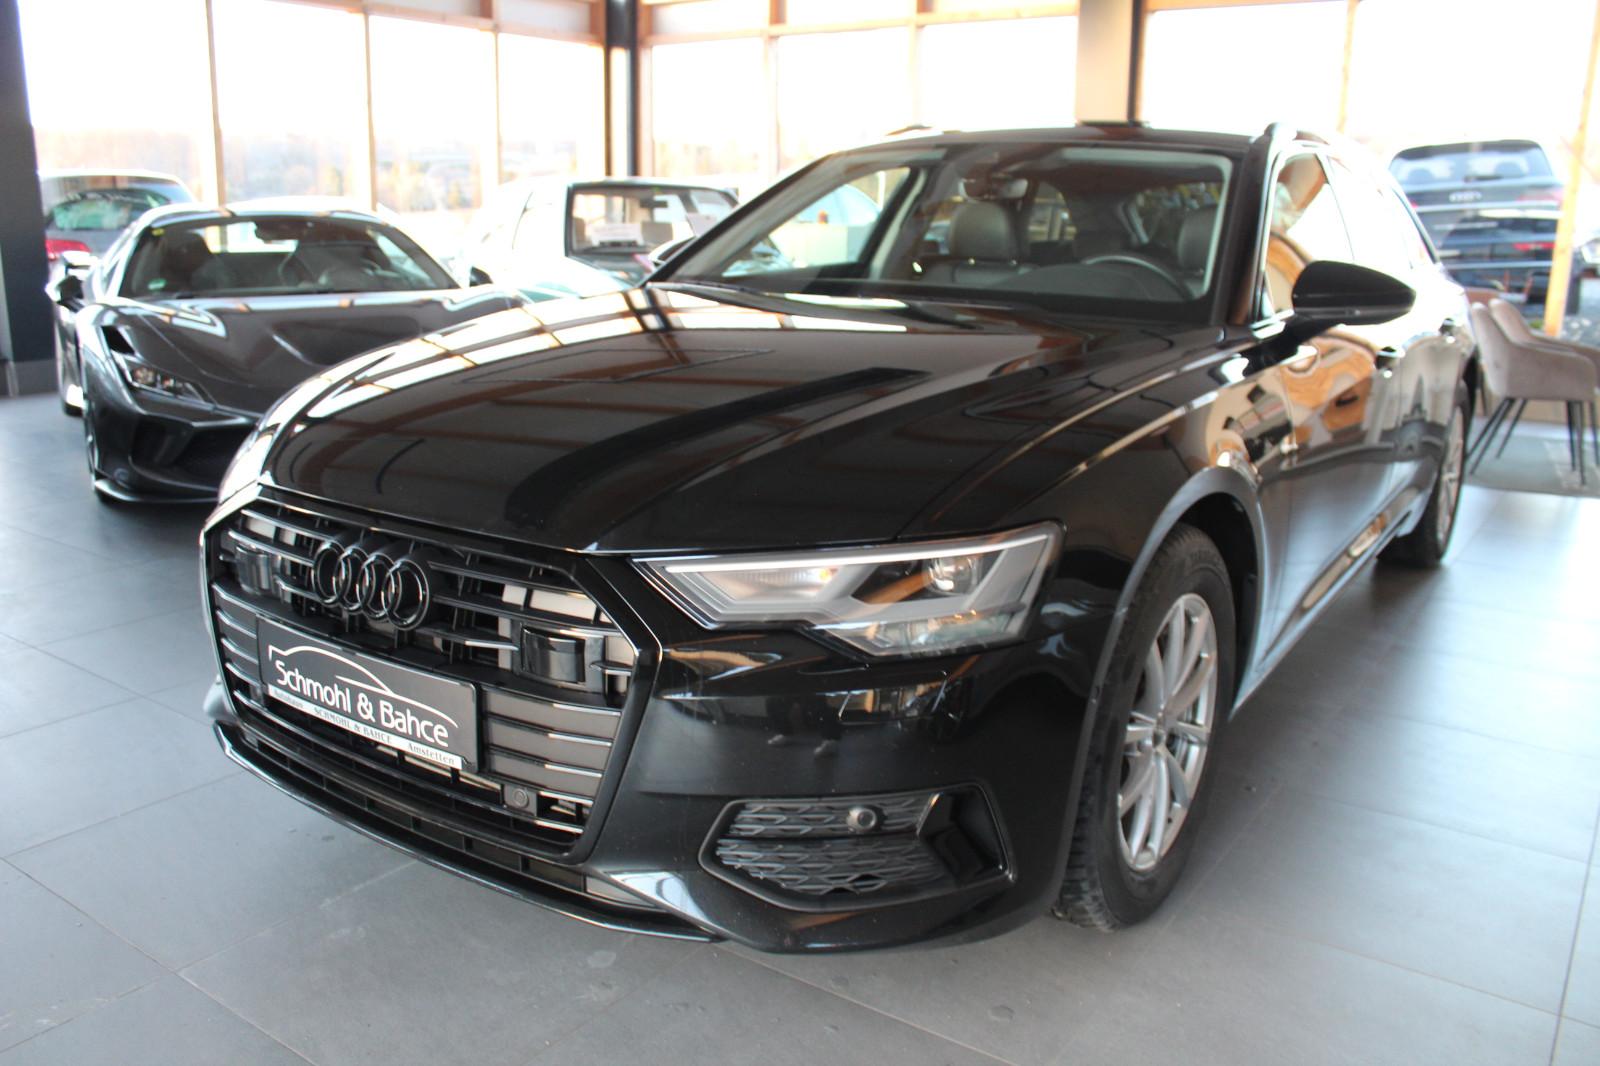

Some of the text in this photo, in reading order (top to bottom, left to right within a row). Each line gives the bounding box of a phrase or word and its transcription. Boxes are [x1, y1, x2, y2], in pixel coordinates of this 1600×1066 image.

[275, 660, 352, 713] Schmohl
[356, 692, 376, 723] &
[380, 700, 449, 748] Bahce
[407, 743, 455, 765] Amstetten
